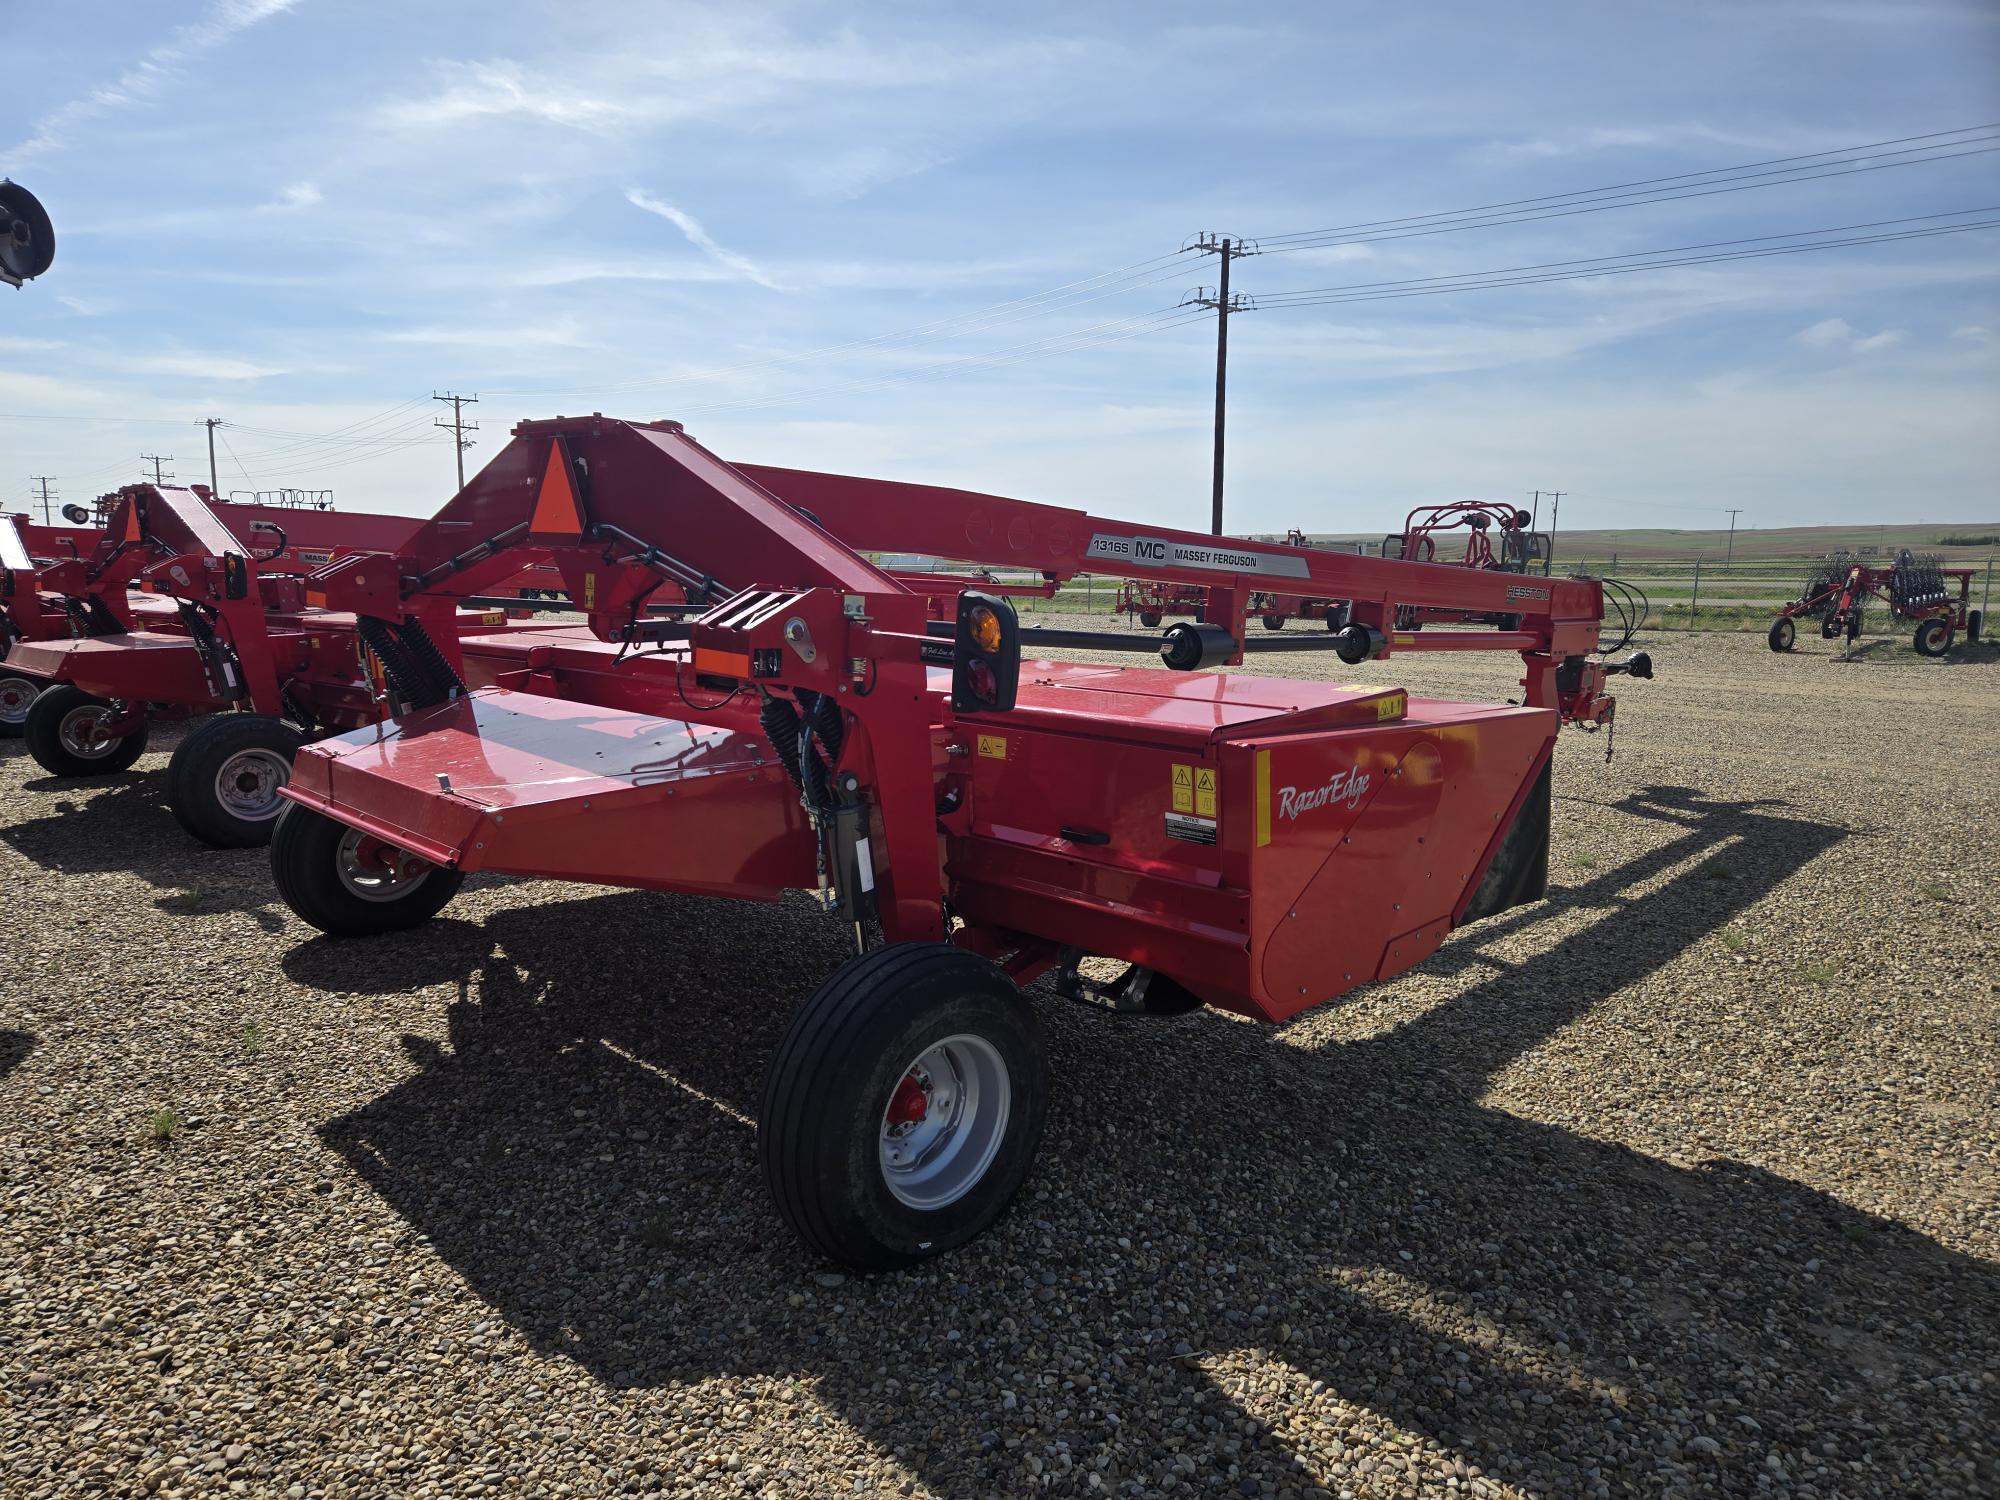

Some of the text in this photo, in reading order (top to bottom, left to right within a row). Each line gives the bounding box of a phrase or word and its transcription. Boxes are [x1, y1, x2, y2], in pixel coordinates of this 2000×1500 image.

[253, 549, 291, 560] 131S
[1093, 539, 1165, 560] 1316S MC
[1174, 548, 1257, 568] MASSEY FERGUSON
[1507, 585, 1550, 601] HESSTON
[1277, 764, 1370, 820] RazorEdge
